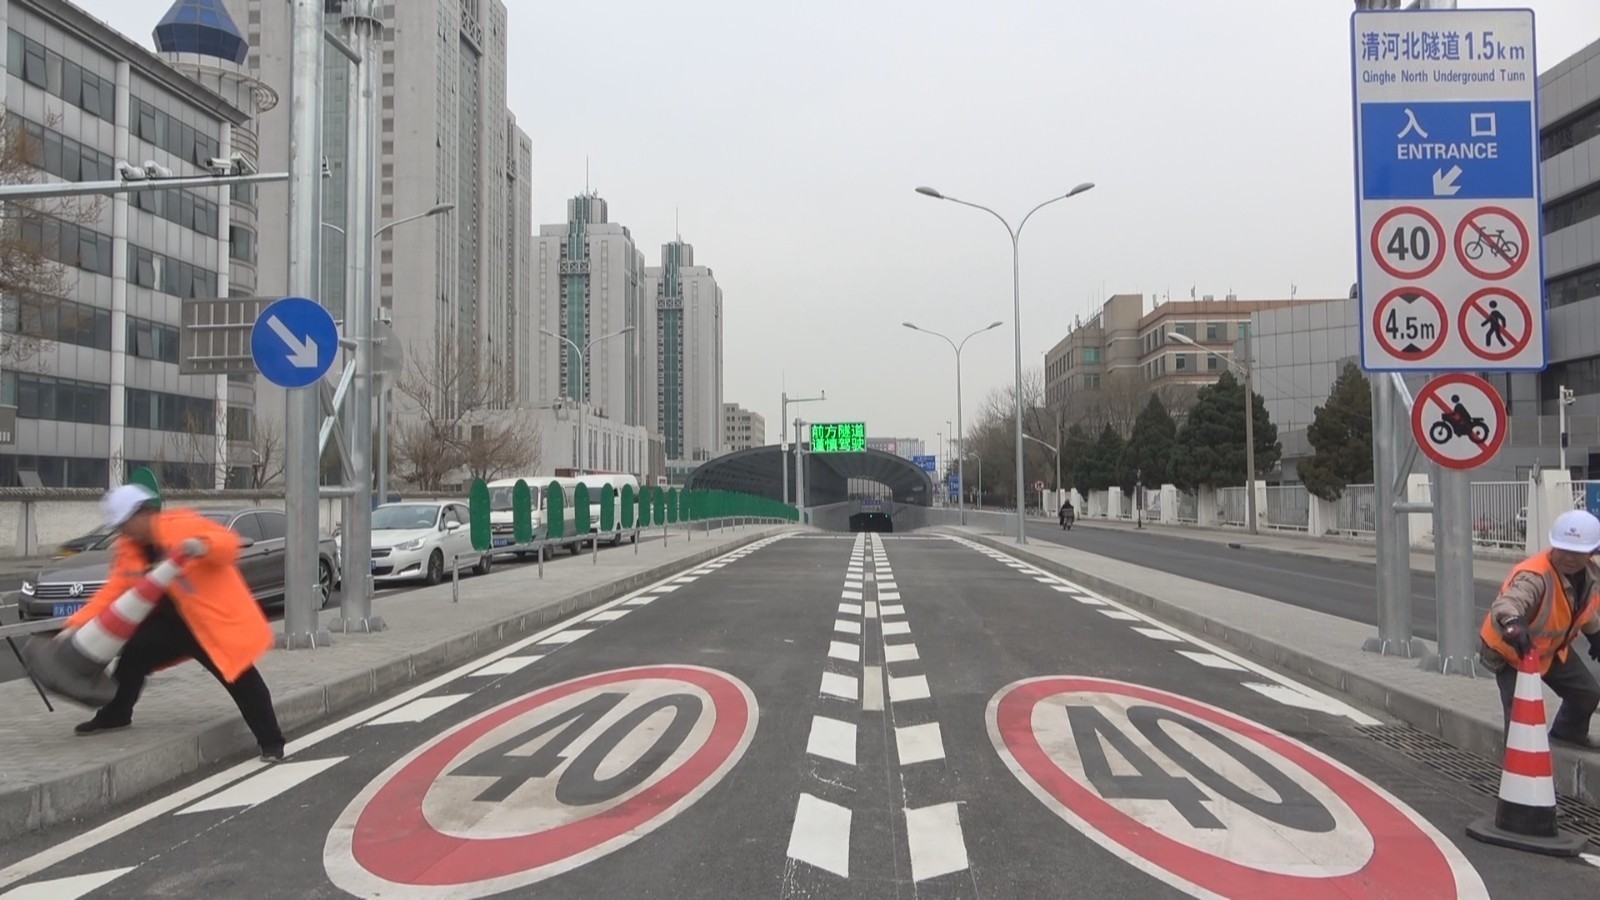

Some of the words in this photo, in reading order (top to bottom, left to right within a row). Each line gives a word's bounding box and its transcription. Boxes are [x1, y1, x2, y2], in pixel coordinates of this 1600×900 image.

[1362, 31, 1460, 61] 清河北隧道
[1362, 70, 1396, 85] Qinghe
[1401, 70, 1428, 83] North
[1433, 69, 1495, 84] Underground
[1500, 69, 1525, 82] Tunn
[1397, 143, 1498, 160] ENTRANCE
[1387, 226, 1431, 261] 40
[1385, 308, 1435, 340] 4.5m
[445, 692, 704, 806] 40
[1065, 705, 1337, 833] 40
